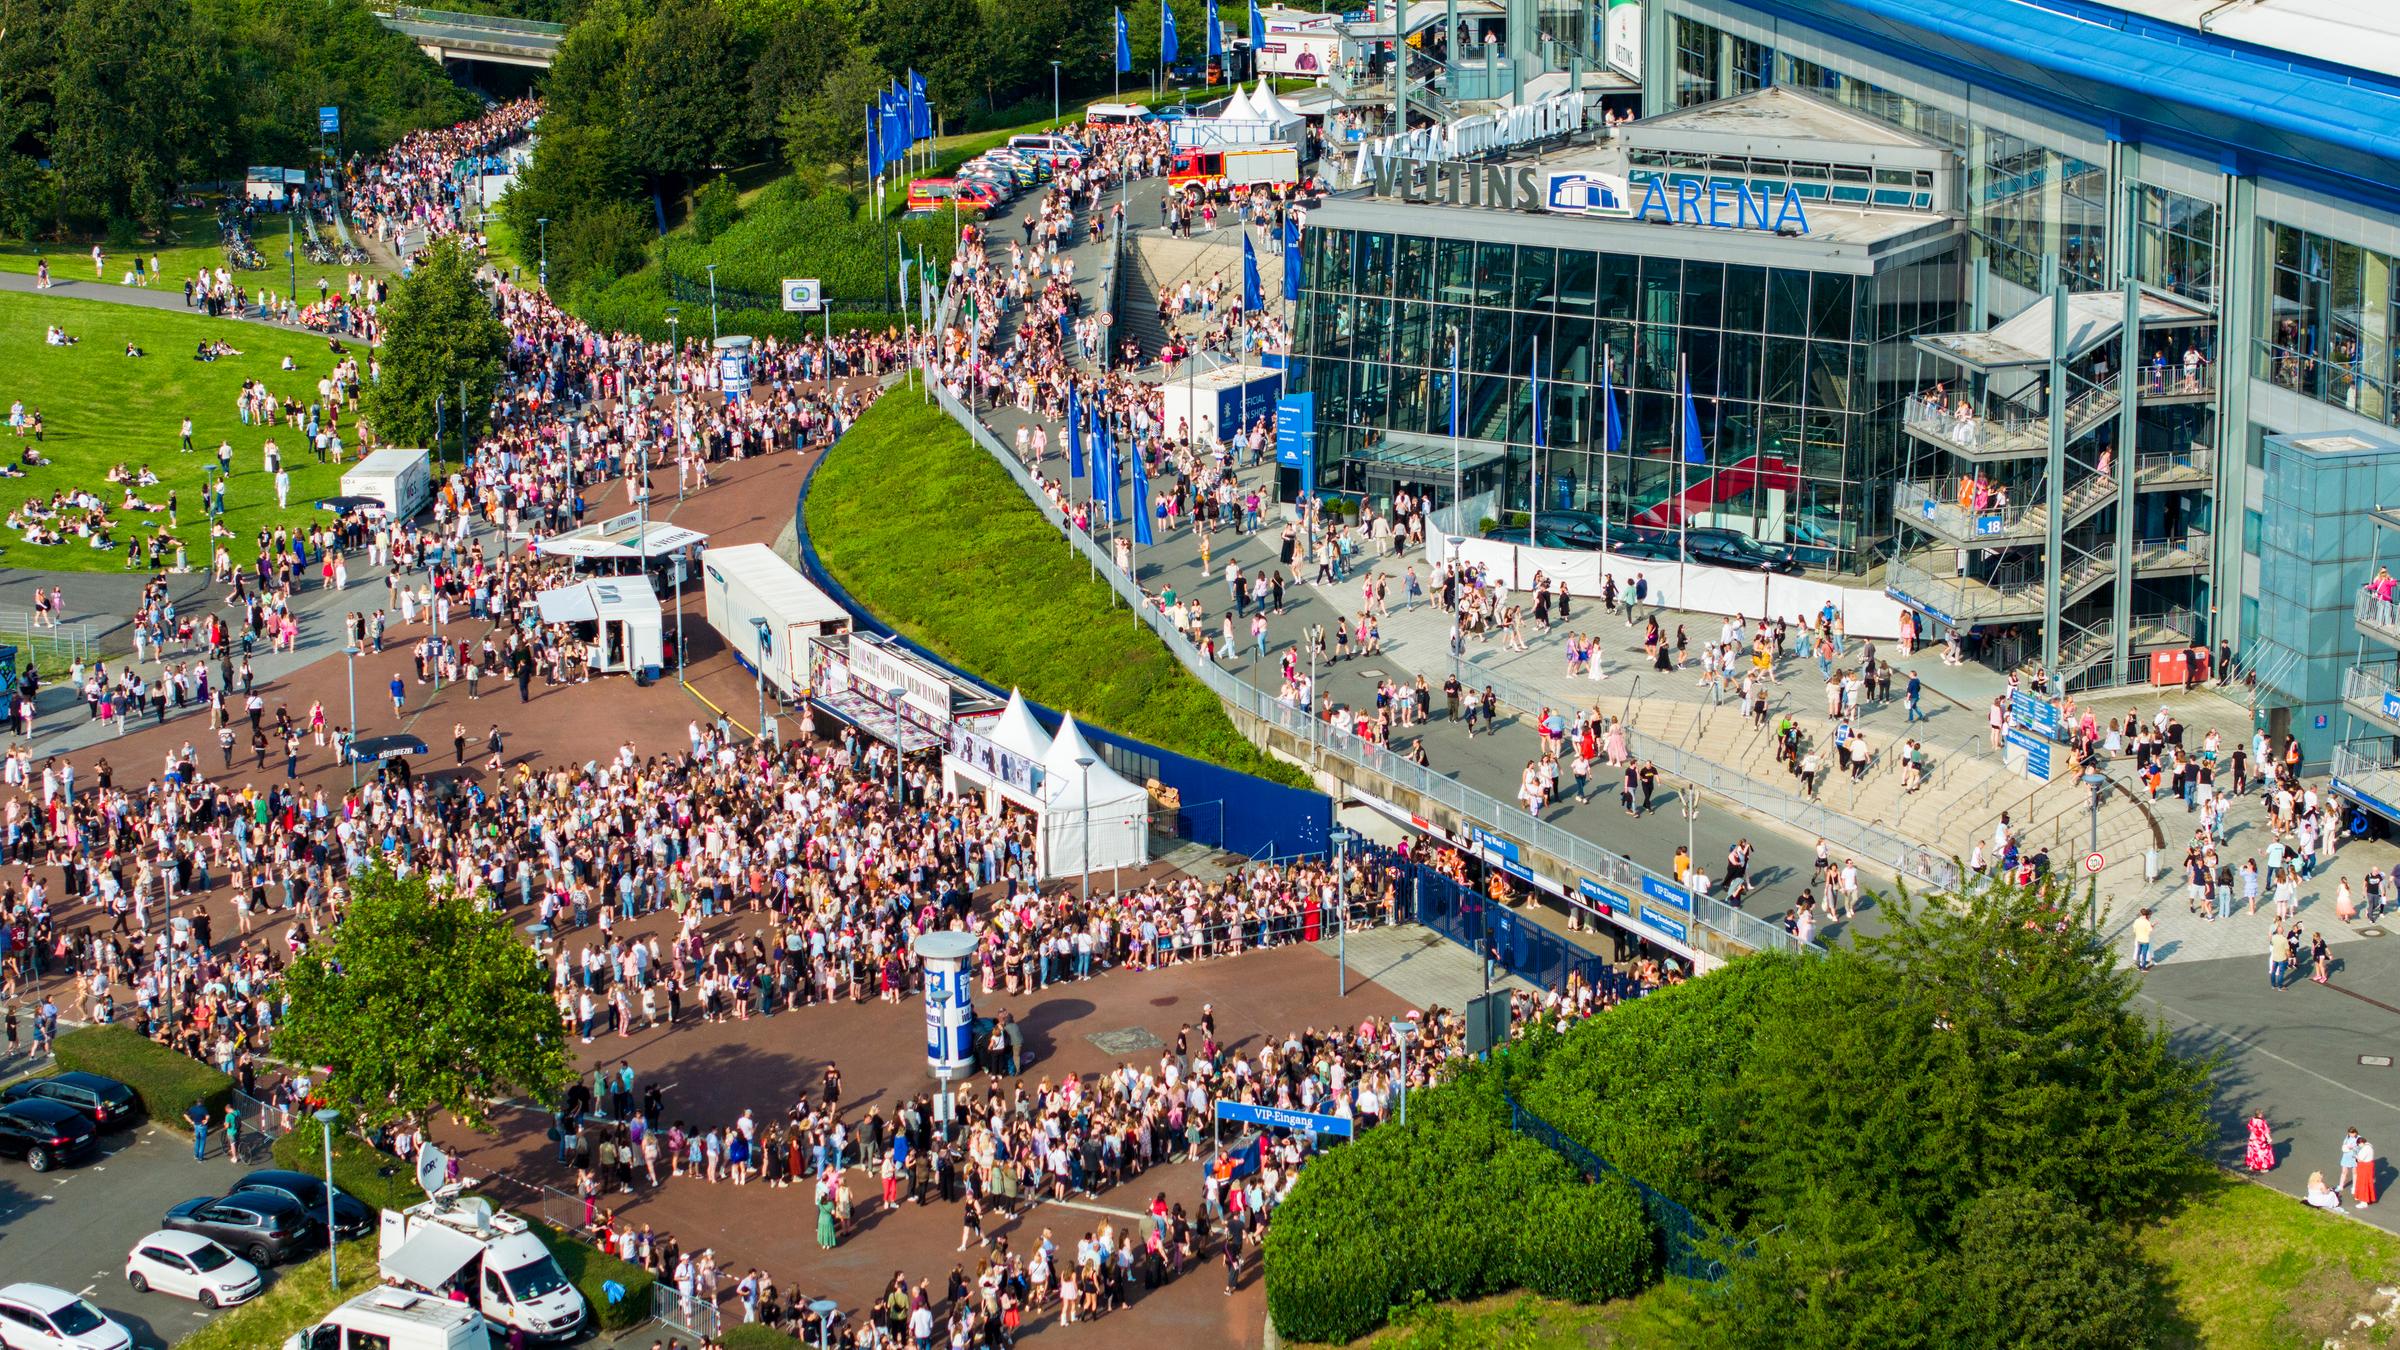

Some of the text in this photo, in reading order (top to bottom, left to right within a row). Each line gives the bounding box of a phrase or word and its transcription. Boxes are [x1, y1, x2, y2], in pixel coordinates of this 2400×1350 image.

[1373, 155, 1812, 235] VELTINS ARENA
[1987, 520, 2000, 533] 18
[663, 530, 695, 546] VELTINS
[1254, 1107, 1314, 1129] VIP-Eingang
